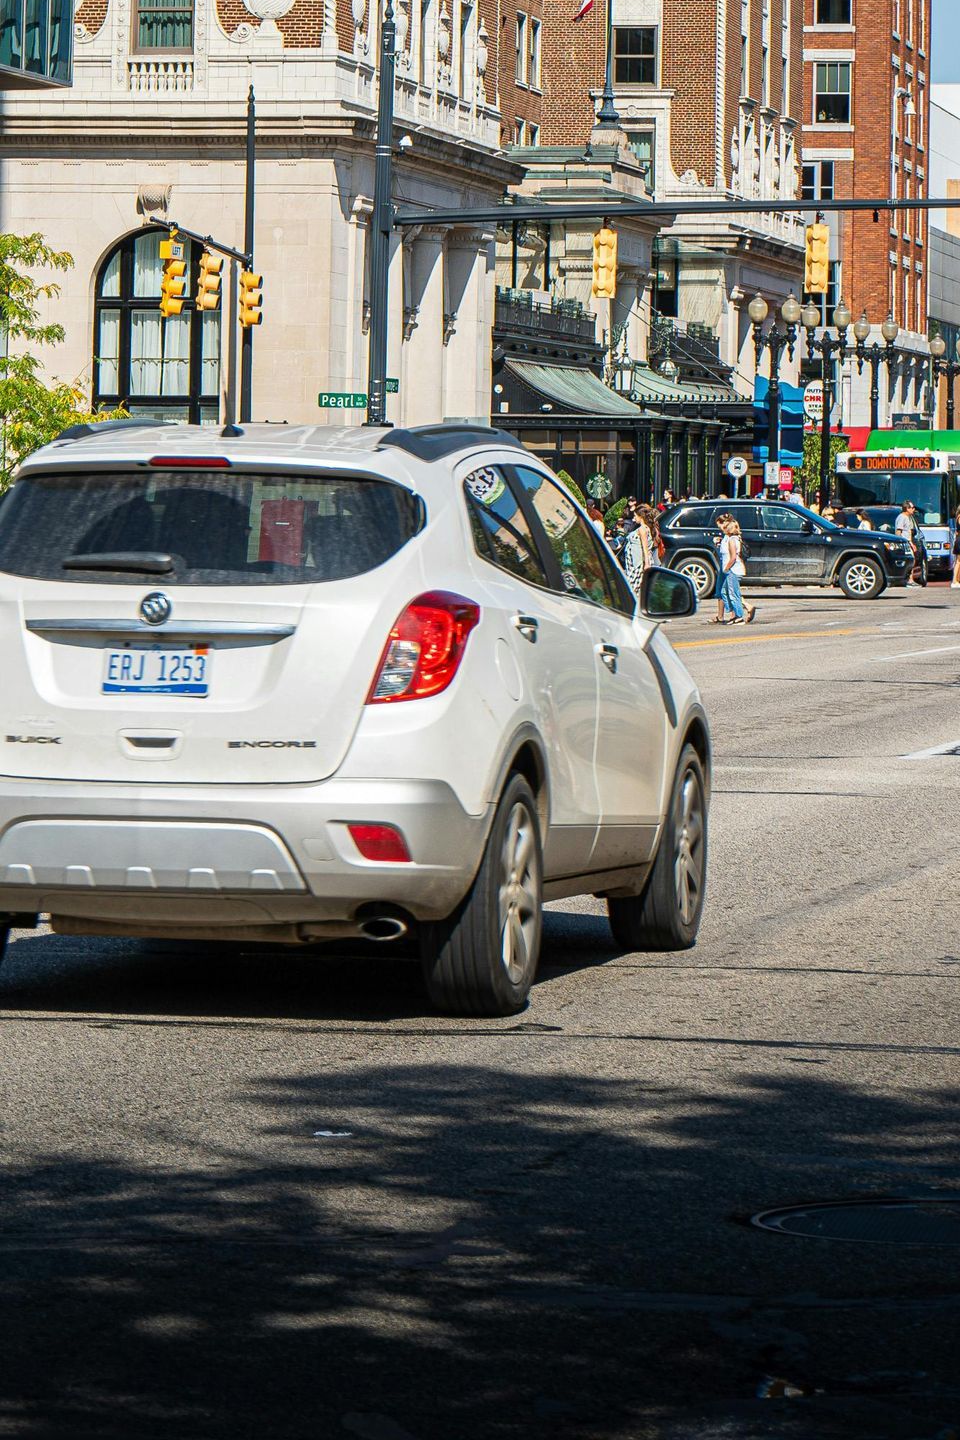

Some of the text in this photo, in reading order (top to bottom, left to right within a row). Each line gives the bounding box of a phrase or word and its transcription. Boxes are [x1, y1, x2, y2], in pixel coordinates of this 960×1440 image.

[322, 394, 354, 407] Pearl
[854, 457, 930, 469] 9 DOWNTOWN/RCS
[108, 654, 206, 681] ERJ 1253
[5, 735, 63, 745] BUICK
[227, 740, 317, 749] ENCORE
